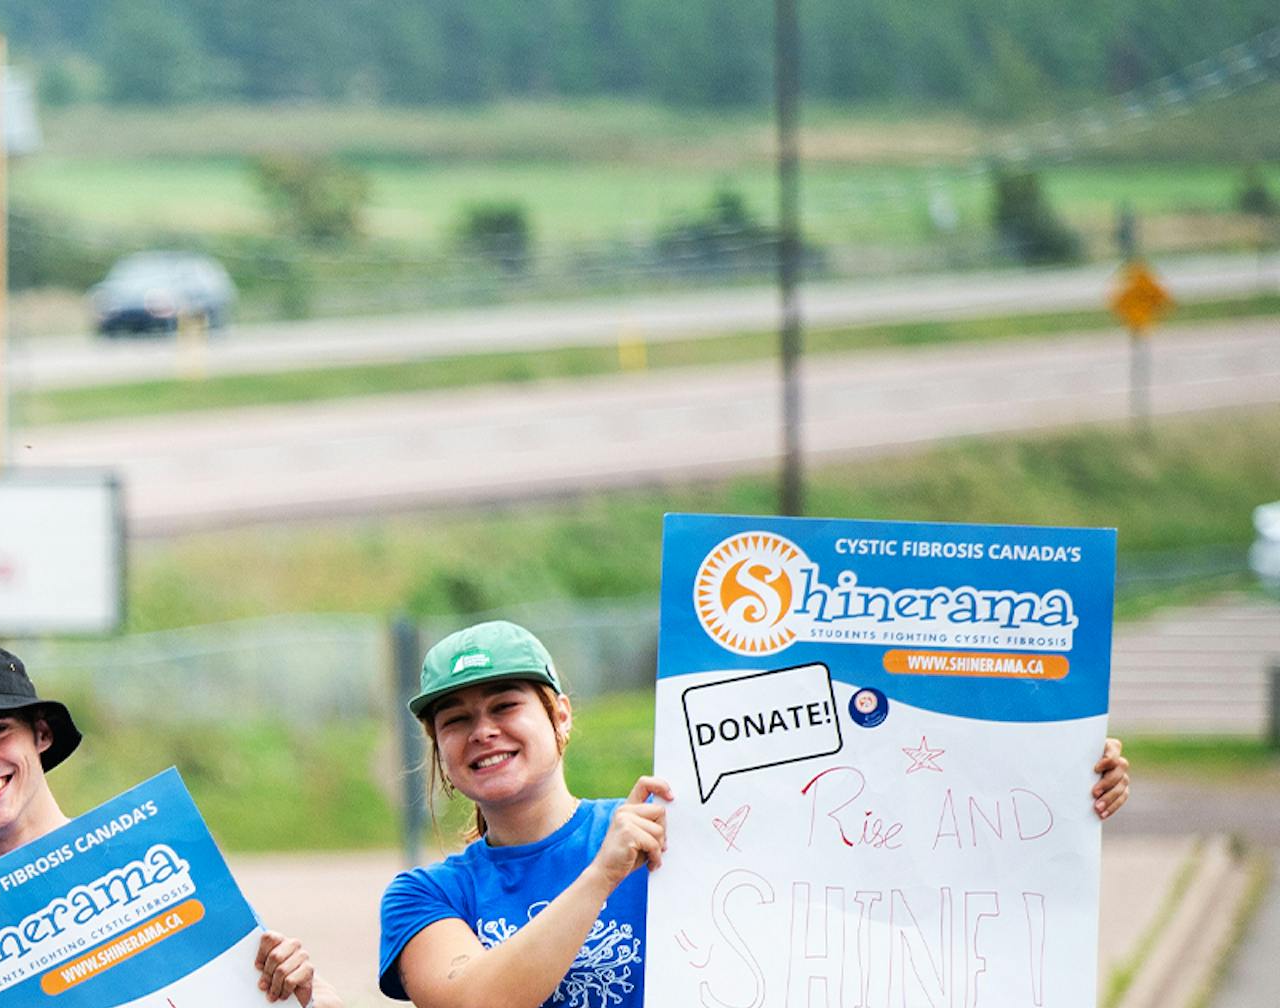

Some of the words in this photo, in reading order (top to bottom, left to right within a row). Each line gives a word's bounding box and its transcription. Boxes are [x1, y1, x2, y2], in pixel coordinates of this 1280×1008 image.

[834, 538, 897, 557] CYSTIC
[901, 540, 984, 560] FIBROSIS
[987, 543, 1082, 563] CANADA'S
[720, 558, 1075, 630] Shinerama
[810, 627, 876, 640] STUDENTS
[883, 631, 949, 643] FIGHTING
[954, 634, 1000, 645] CYSTIC
[1006, 636, 1068, 648] FIBROSIS
[907, 655, 1044, 675] WWW.SHINERAMA.CA
[695, 701, 832, 748] DONATE!
[801, 766, 904, 851] Rise
[932, 787, 1054, 851] AND
[1, 844, 75, 892] FIBROSIS
[75, 800, 159, 855] CANADA'S
[29, 939, 85, 973] FIGHTING
[90, 916, 132, 941] CYSTIC
[135, 883, 190, 917] FIBROSIS
[60, 911, 184, 985] WWW.SHINERAMA.CA
